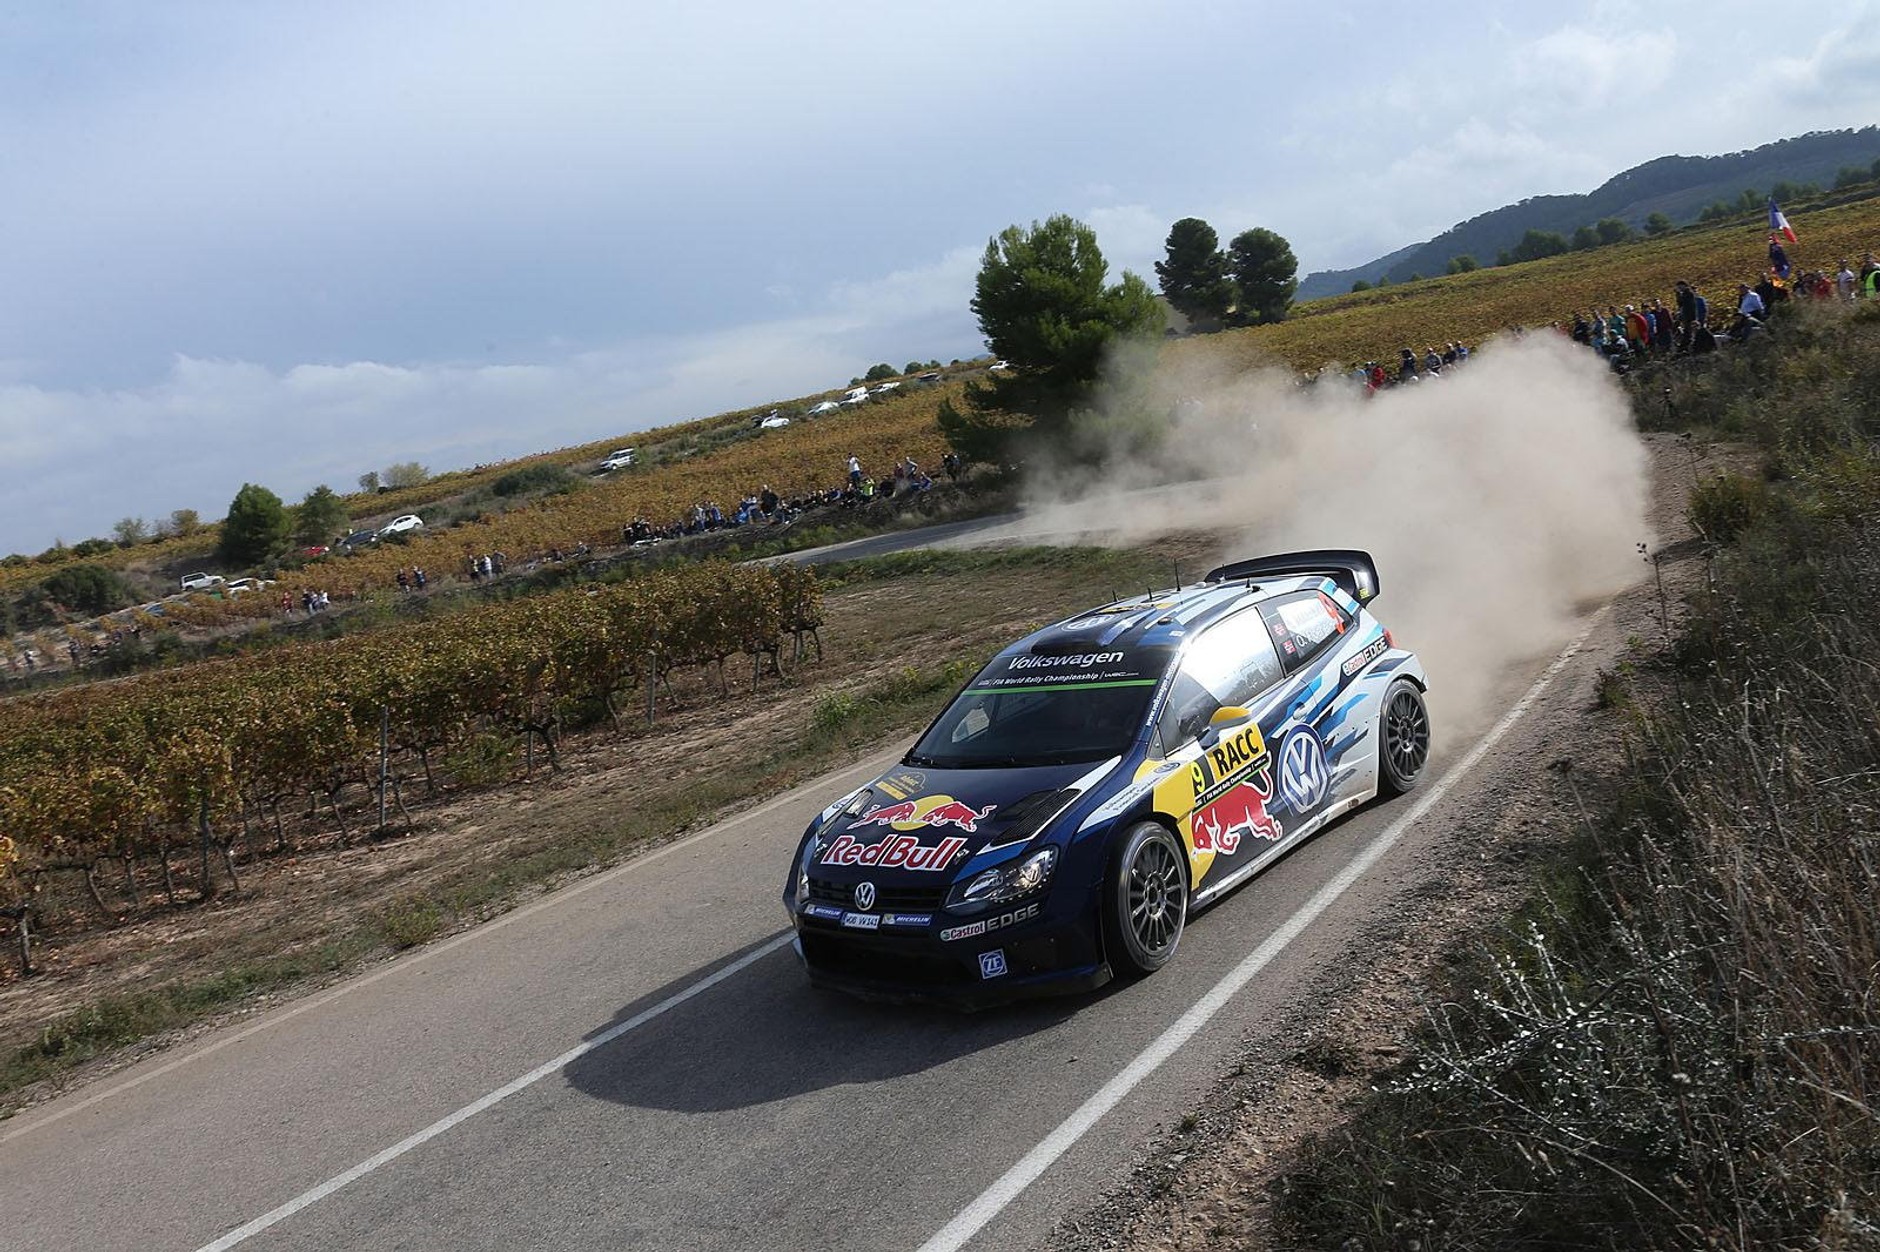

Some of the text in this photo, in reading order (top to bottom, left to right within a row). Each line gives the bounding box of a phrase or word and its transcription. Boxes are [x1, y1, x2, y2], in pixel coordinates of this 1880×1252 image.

[1008, 651, 1124, 670] Volkswagen
[1364, 636, 1388, 661] EDGE
[1005, 677, 1023, 685] World
[1025, 675, 1042, 684] Rally
[1044, 672, 1098, 683] Championship
[1212, 728, 1260, 776] RACC
[1190, 760, 1206, 793] 9
[822, 835, 965, 870] Red Bull
[815, 907, 841, 916] MICHELIN
[950, 902, 1040, 939] Castrol EDGE
[983, 956, 1004, 972] ZF
